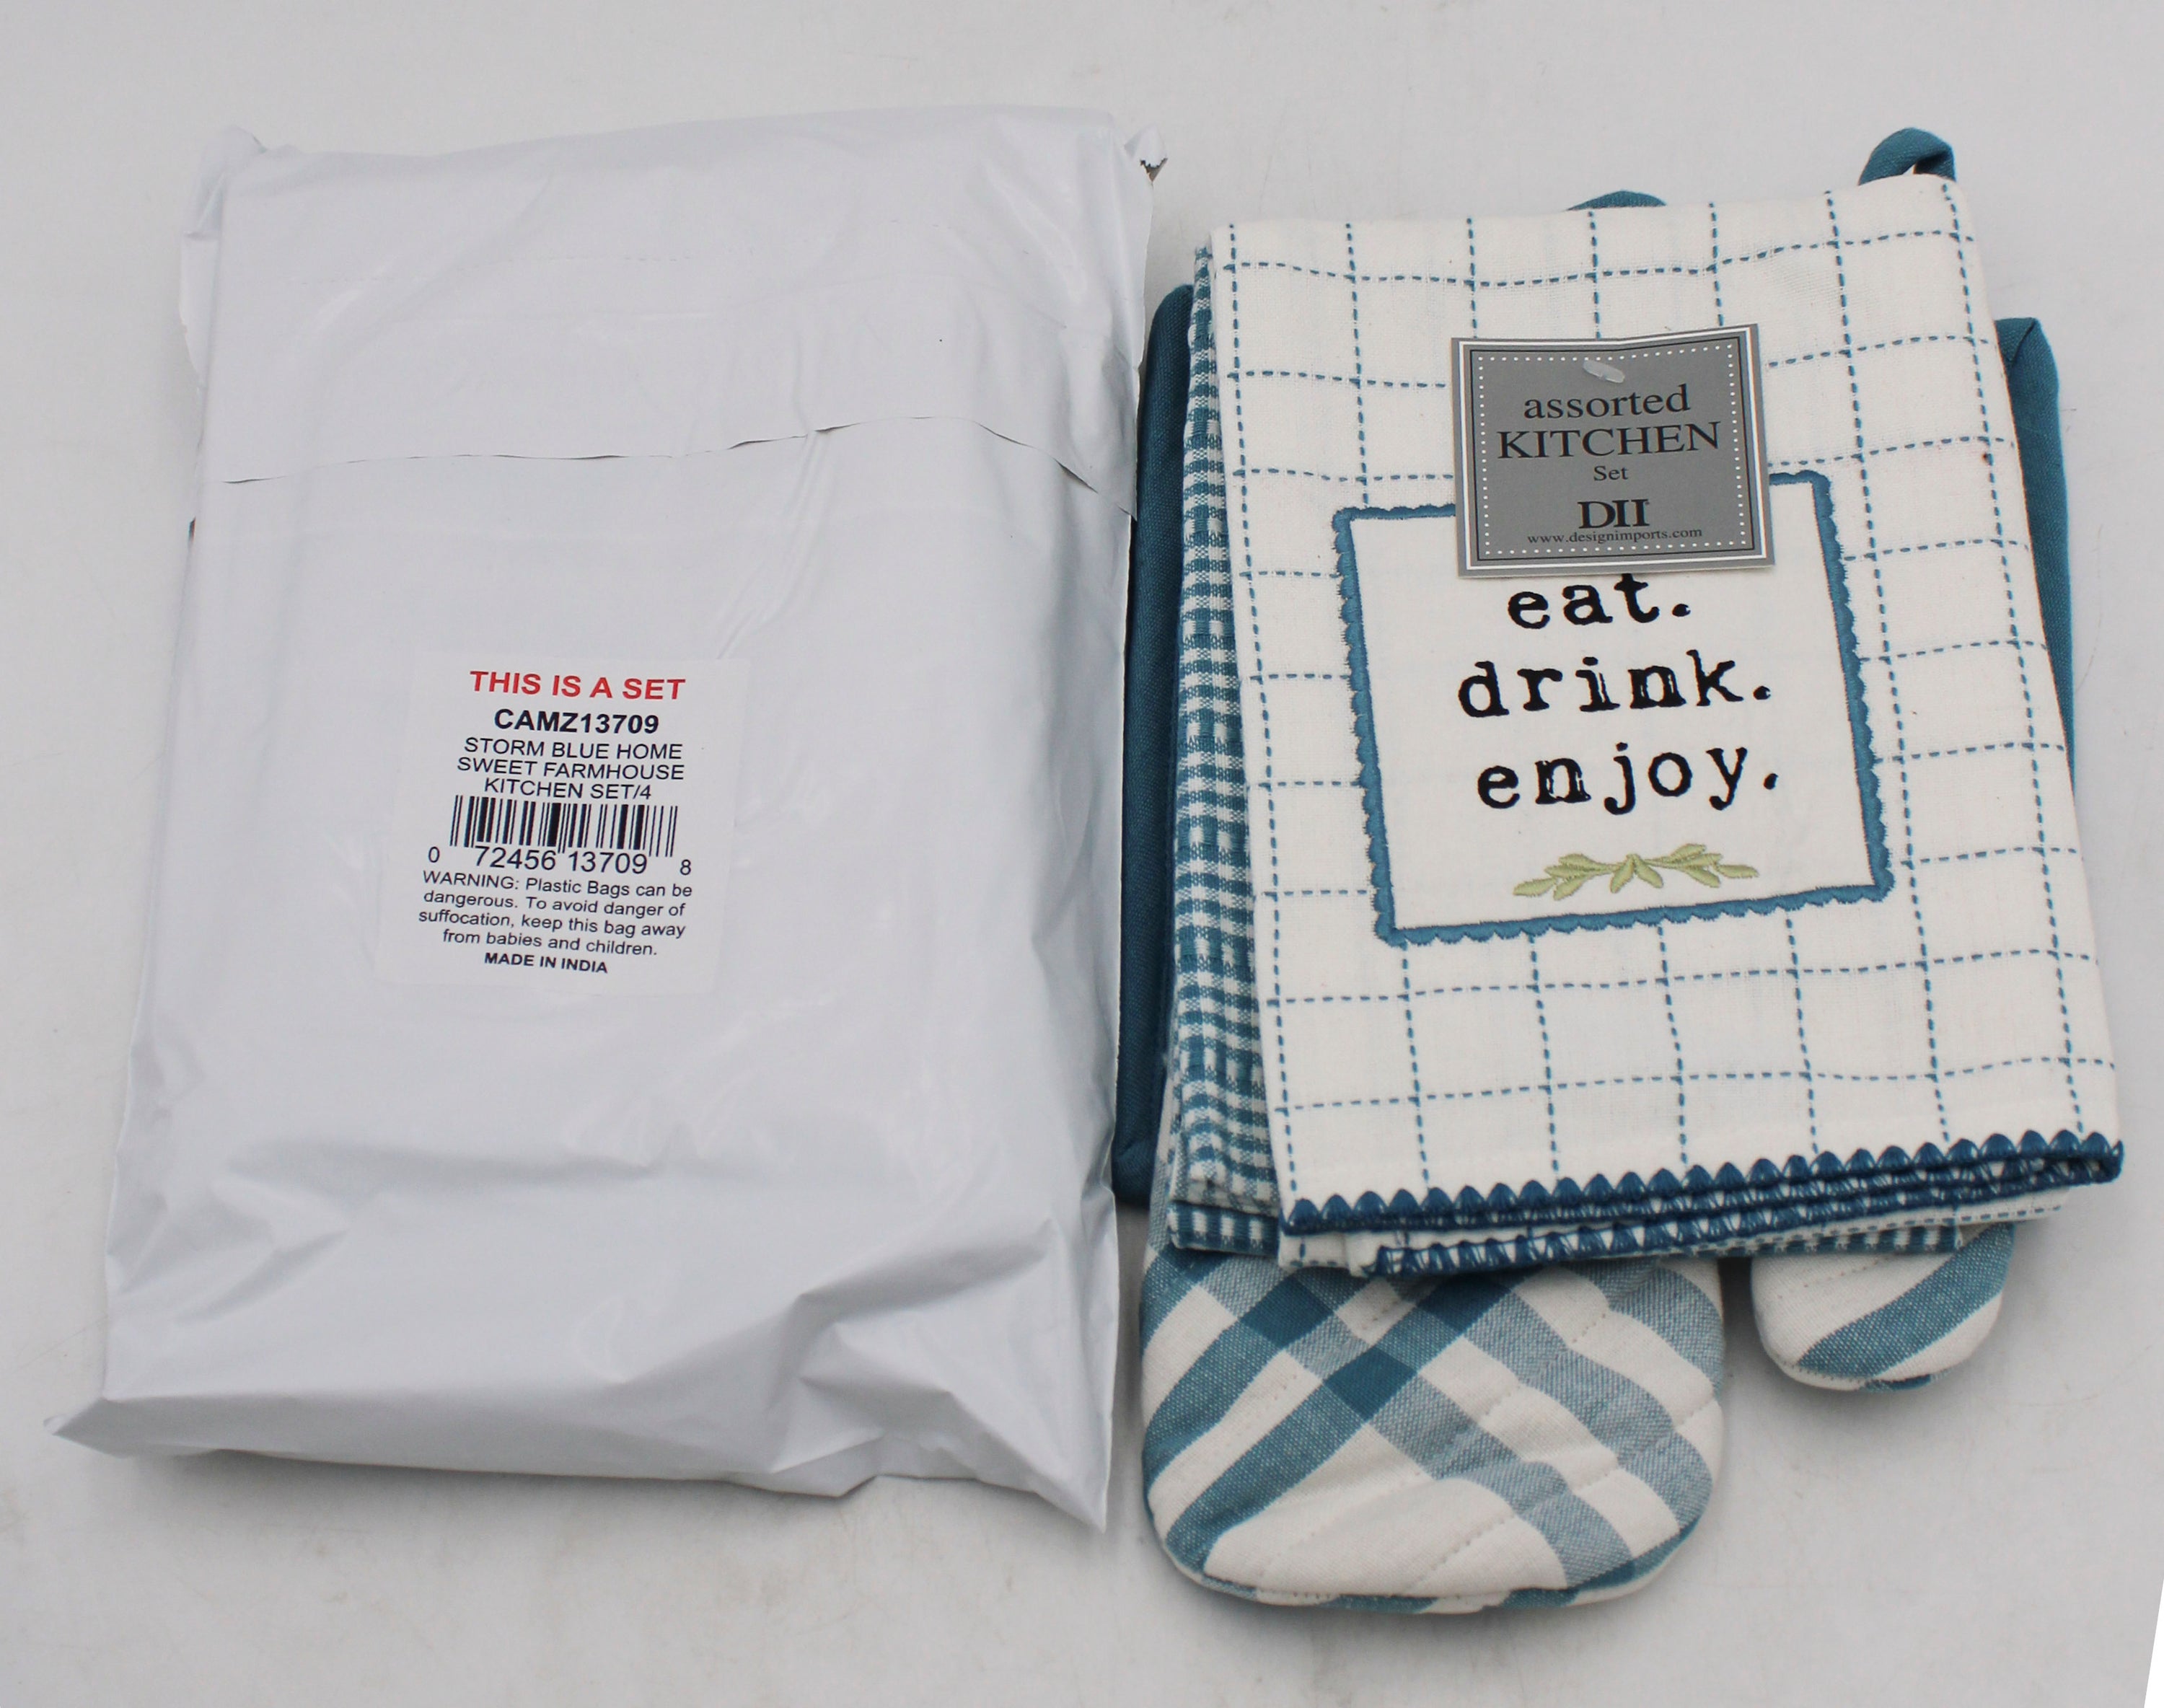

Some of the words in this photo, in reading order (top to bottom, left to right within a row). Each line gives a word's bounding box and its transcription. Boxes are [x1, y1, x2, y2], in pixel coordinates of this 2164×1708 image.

[1524, 384, 1690, 418] assorted
[1497, 421, 1720, 459] KITCHEN
[1593, 465, 1628, 480] Set
[1578, 498, 1650, 529] DII
[1527, 527, 1702, 544] www.designimports.com
[1508, 574, 1691, 629] eat.
[470, 671, 541, 695] THIS
[553, 675, 581, 697] IS
[589, 677, 613, 698] A
[623, 679, 685, 700] SET
[1458, 650, 1772, 718] drink.
[494, 709, 659, 734] CAMZ13709
[465, 737, 545, 757] STORM
[552, 743, 609, 759] BLUE
[617, 744, 683, 760] HOME
[457, 758, 537, 776] SWEET
[544, 762, 685, 780] FARMHOUSE
[1477, 742, 1777, 814] enjoy.
[484, 778, 583, 798] KITCHEN
[591, 784, 651, 800] SET/4
[428, 847, 440, 863] 0
[475, 845, 557, 870] 72456
[569, 851, 648, 874] 13709
[680, 860, 691, 876] 8
[423, 871, 519, 890] WARNING:
[526, 878, 581, 894] Plastic
[587, 881, 630, 899] Bags
[635, 884, 665, 897] can
[672, 884, 692, 897] be
[423, 891, 519, 909] dangerous.
[526, 897, 546, 910] To
[553, 899, 598, 913] avoid
[604, 902, 662, 918] danger
[669, 903, 686, 917] of
[419, 910, 514, 928] suffocation,
[522, 916, 563, 933] keep
[569, 918, 598, 933] this
[604, 921, 635, 938] bag
[641, 924, 686, 939] away
[443, 929, 480, 944] from
[486, 932, 542, 947] babies
[548, 937, 580, 950] and
[586, 938, 657, 956] children.
[484, 953, 534, 967] MADE
[540, 956, 556, 968] IN
[562, 959, 608, 973] INDIA
